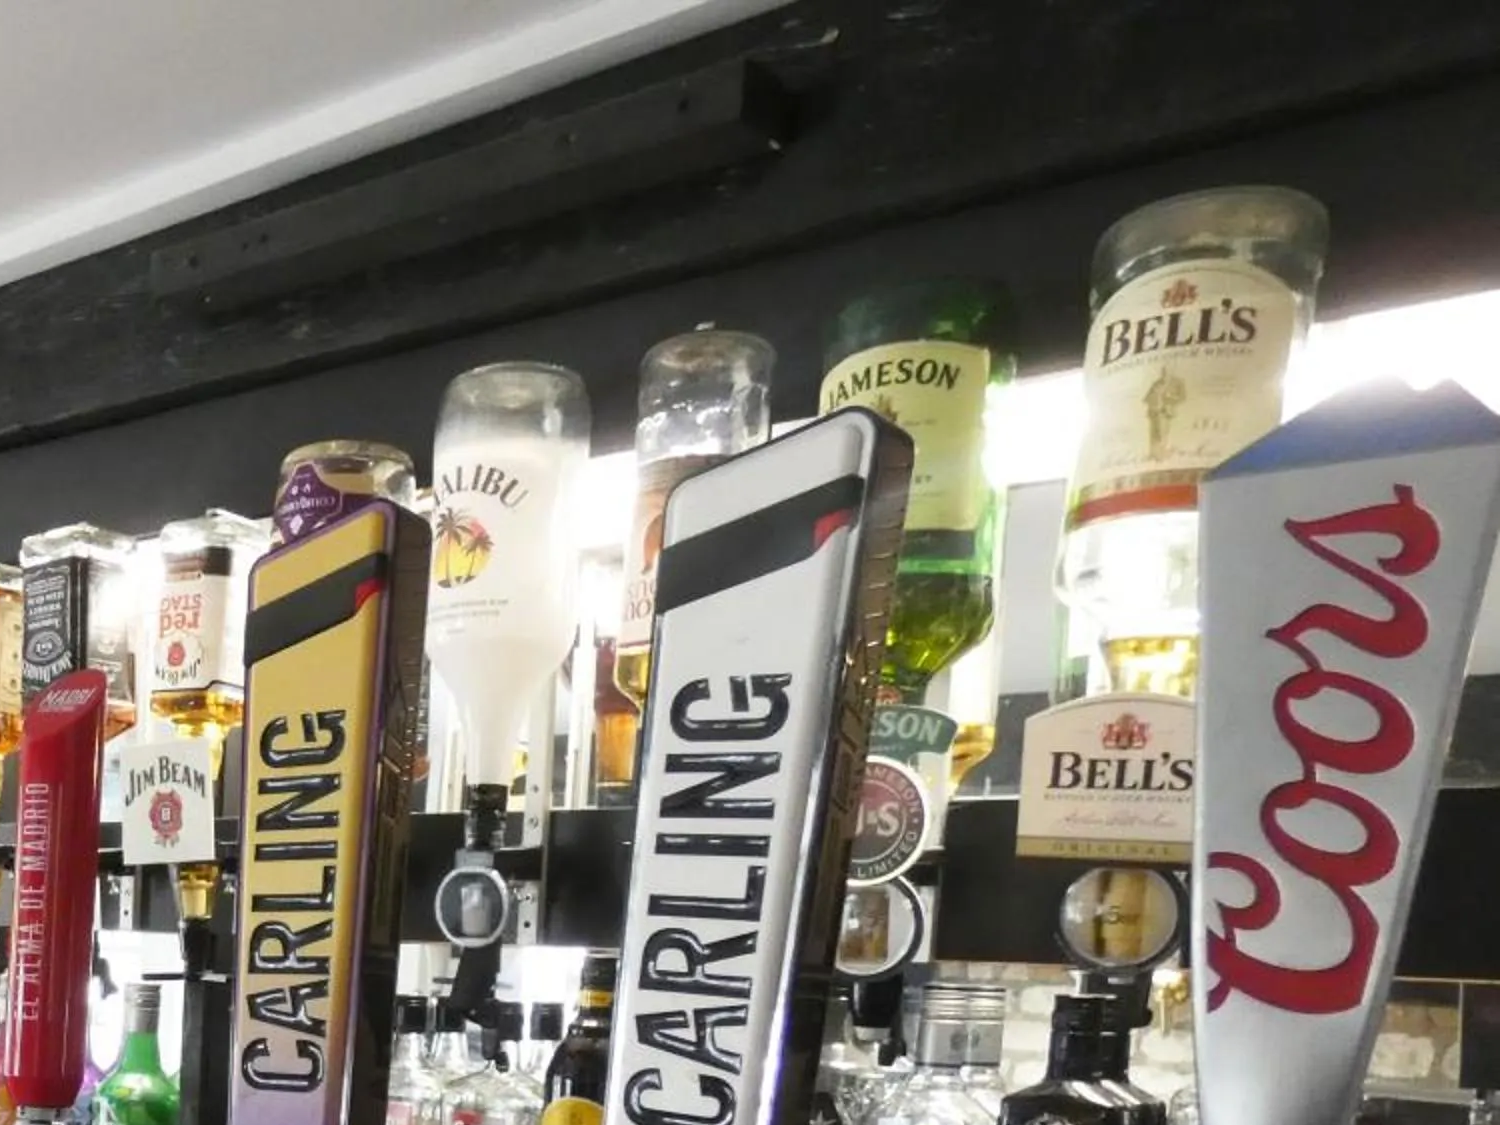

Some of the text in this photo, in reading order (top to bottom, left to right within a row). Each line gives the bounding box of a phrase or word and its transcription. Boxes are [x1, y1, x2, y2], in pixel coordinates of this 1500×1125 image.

[1102, 298, 1257, 366] BELL'S
[828, 359, 961, 411] JAMESON
[160, 610, 200, 638] red
[1047, 751, 1194, 792] BELL'S
[1206, 484, 1442, 1014] Coors
[125, 756, 206, 807] JIM BEAM
[20, 885, 45, 909] DE
[241, 709, 346, 1093] CARLING
